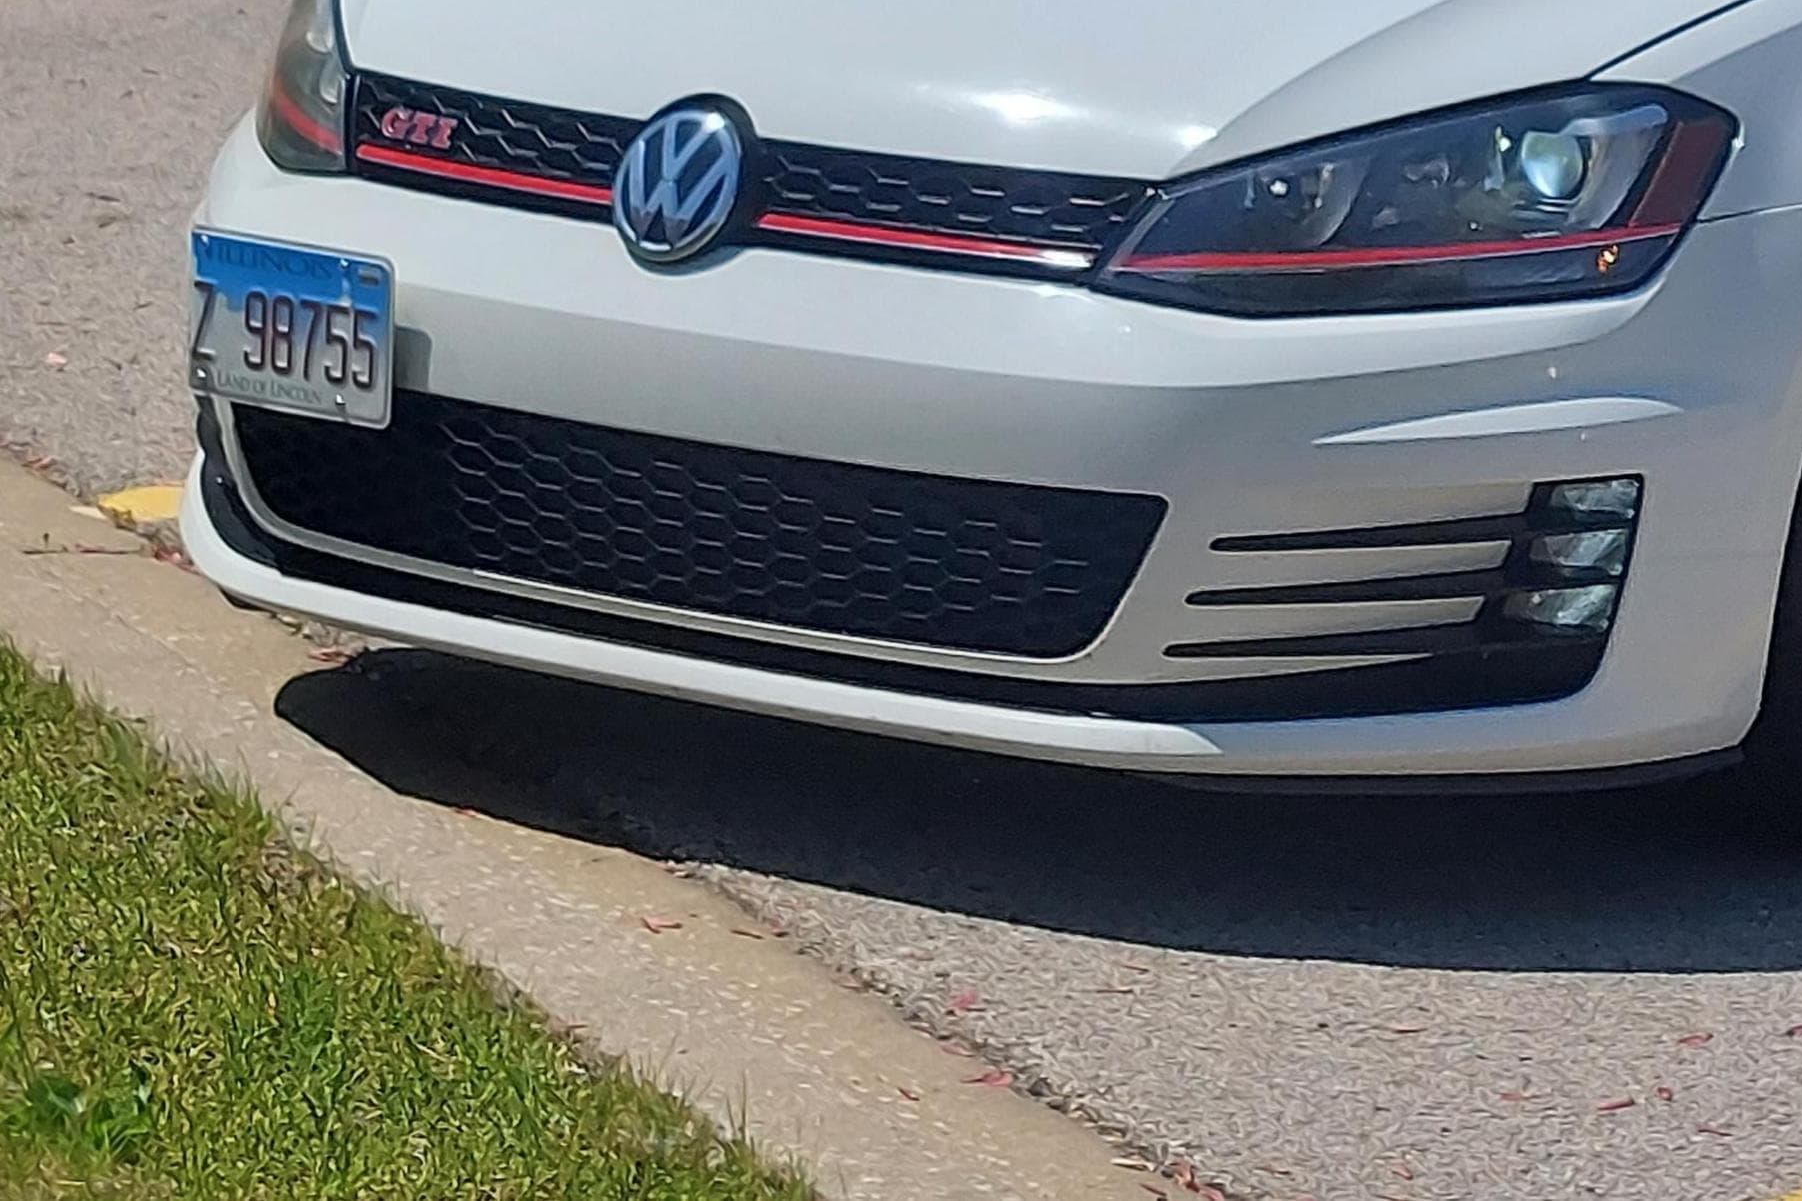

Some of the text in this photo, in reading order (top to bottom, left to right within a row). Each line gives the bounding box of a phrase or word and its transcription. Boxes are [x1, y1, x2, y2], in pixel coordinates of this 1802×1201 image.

[381, 107, 459, 150] GTI
[613, 109, 743, 260] VW
[216, 242, 334, 280] ILLINOIS
[192, 278, 378, 390] Z 98755
